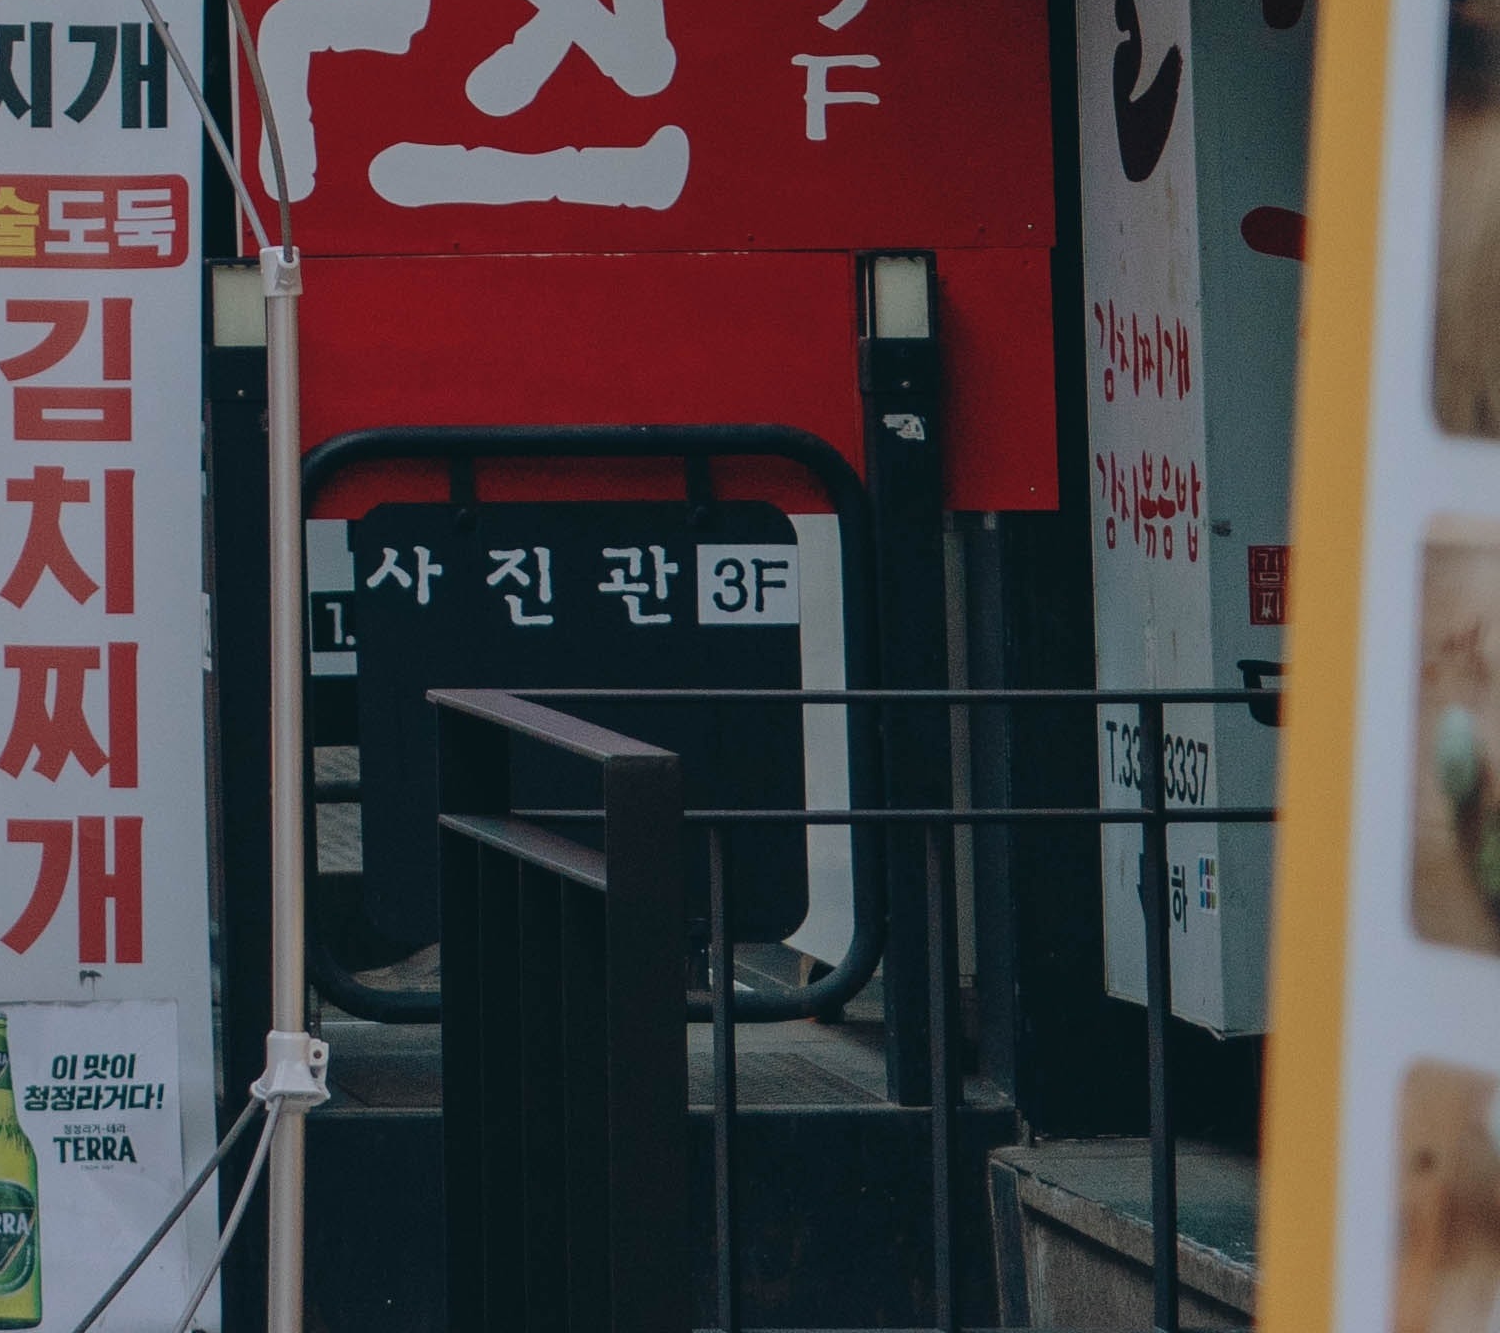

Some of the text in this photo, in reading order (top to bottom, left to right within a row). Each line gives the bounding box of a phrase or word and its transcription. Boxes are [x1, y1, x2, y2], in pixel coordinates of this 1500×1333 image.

[365, 544, 791, 626] 사진관 3F
[51, 1053, 136, 1080] 이 맛이
[23, 1081, 165, 1112] 청정라거다!
[52, 1136, 138, 1165] TERRA
